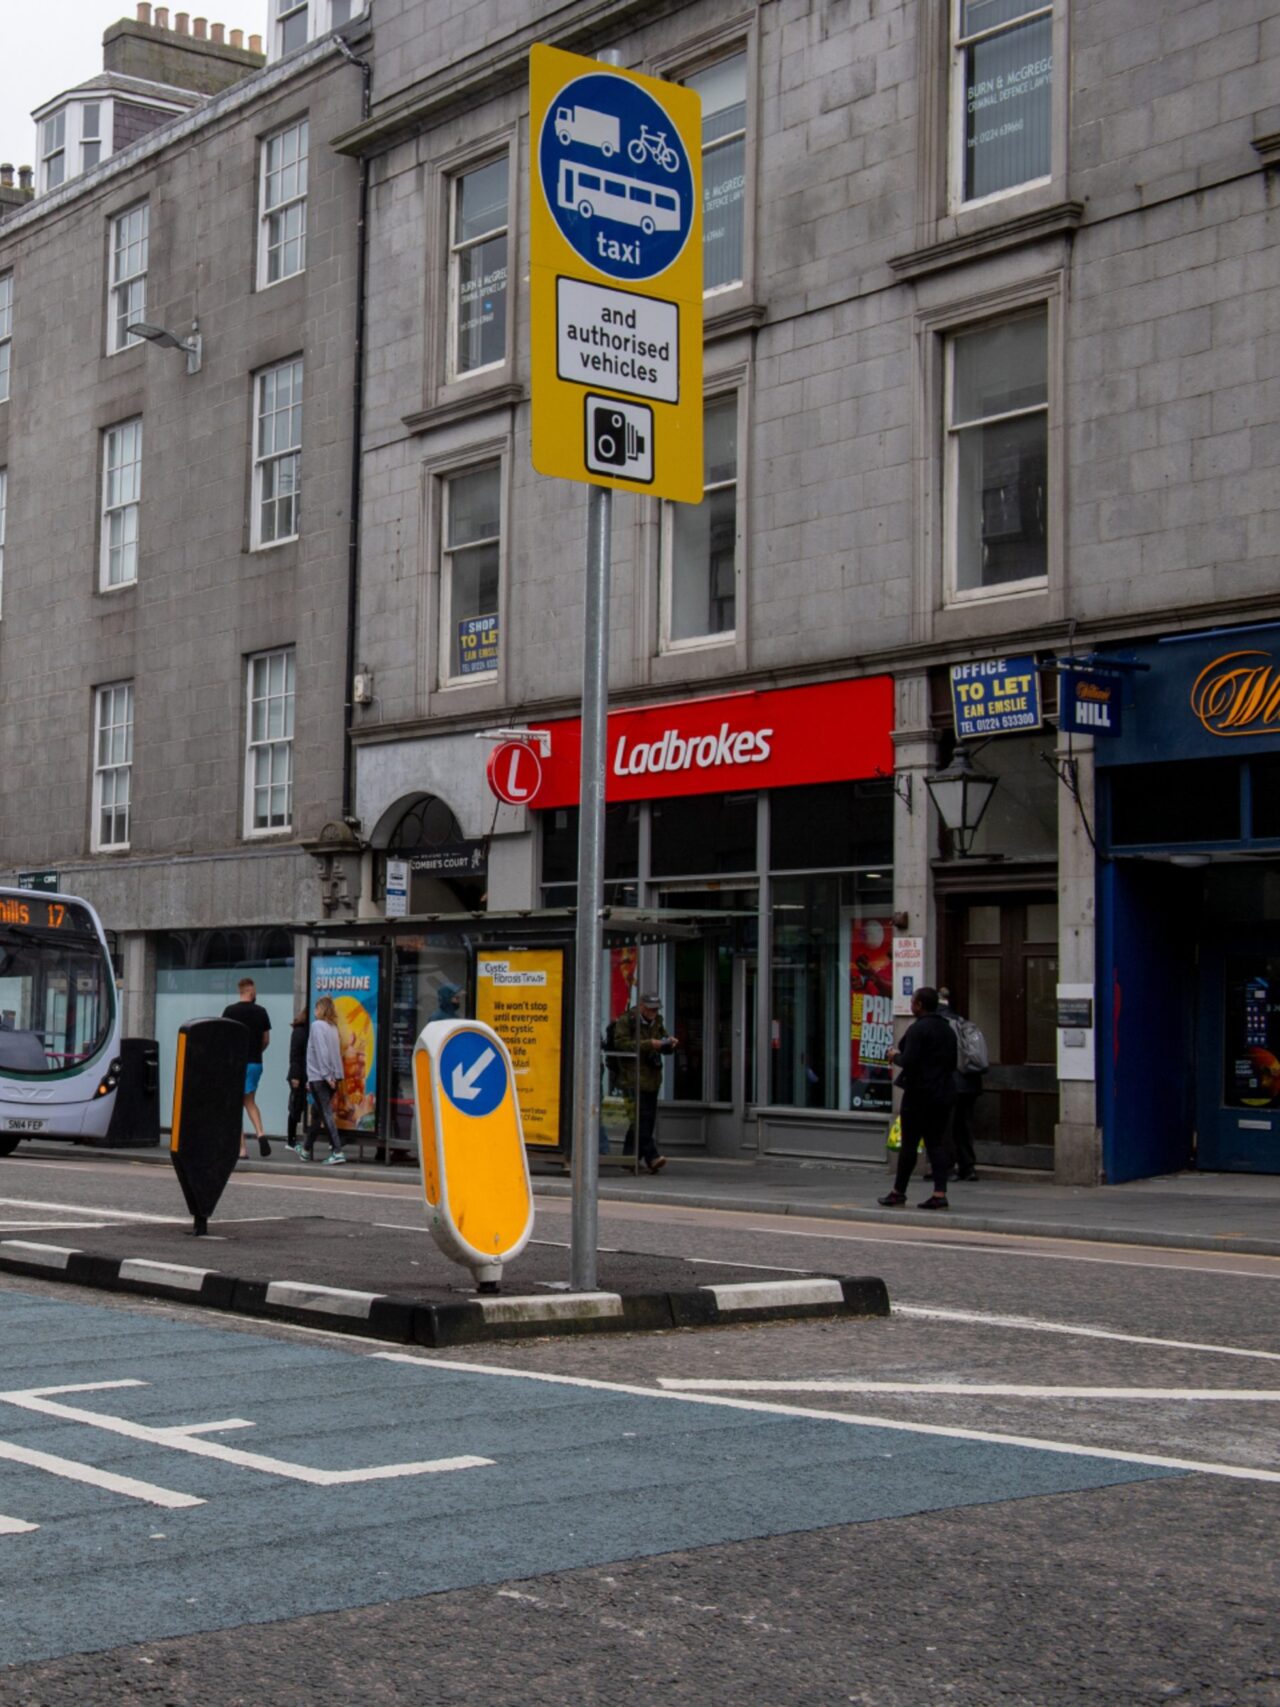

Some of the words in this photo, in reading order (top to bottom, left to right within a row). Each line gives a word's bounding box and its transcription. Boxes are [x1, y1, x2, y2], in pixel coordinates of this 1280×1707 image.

[968, 80, 994, 99] BURN
[999, 82, 1029, 102] DEFENCE
[596, 231, 641, 265] taxi
[601, 307, 636, 329] and
[567, 324, 670, 361] authorised
[580, 352, 658, 384] vehicles
[468, 618, 495, 633] SHOP
[461, 634, 477, 649] TO
[953, 659, 1007, 680] OFFICE
[957, 682, 984, 702] TO
[992, 675, 1031, 697] LET
[963, 703, 985, 718] EAN
[988, 697, 1028, 714] EMSLIE
[1076, 701, 1111, 727] HILL
[960, 720, 975, 733] TEL
[976, 716, 1000, 731] 01224
[1002, 712, 1034, 727] 633300
[613, 723, 773, 776] Ladbrokes
[507, 749, 527, 797] L
[444, 857, 469, 868] COURT
[48, 903, 65, 929] 17
[484, 963, 508, 976] Cystic
[494, 973, 521, 984] Fibrosis
[316, 976, 371, 991] SUNSHINE
[506, 1001, 529, 1010] won't
[531, 1001, 548, 1012] stop
[493, 1013, 510, 1022] until
[511, 1014, 549, 1025] everyone
[510, 1025, 534, 1036] cystic
[862, 1022, 894, 1045] BOOS
[513, 1046, 527, 1056] life
[522, 1037, 537, 1045] can
